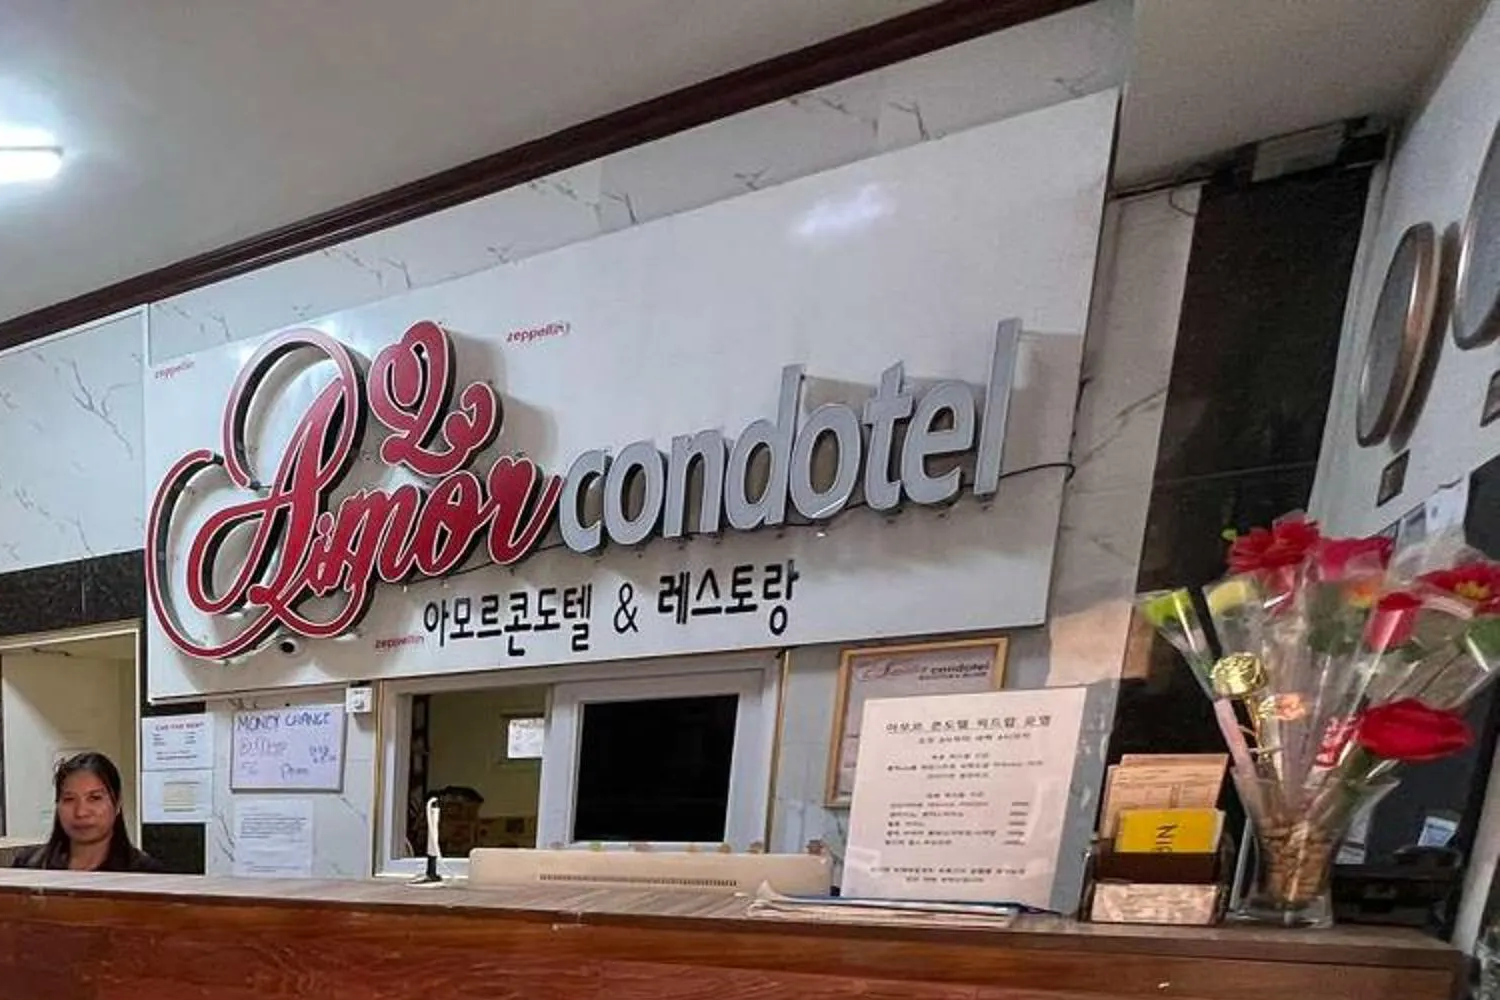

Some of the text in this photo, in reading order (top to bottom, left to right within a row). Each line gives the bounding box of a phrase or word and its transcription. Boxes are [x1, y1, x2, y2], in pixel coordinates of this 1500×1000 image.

[146, 317, 1022, 660] Amor condotel
[423, 560, 799, 657] 아모르콘도텔 & 레스토랑
